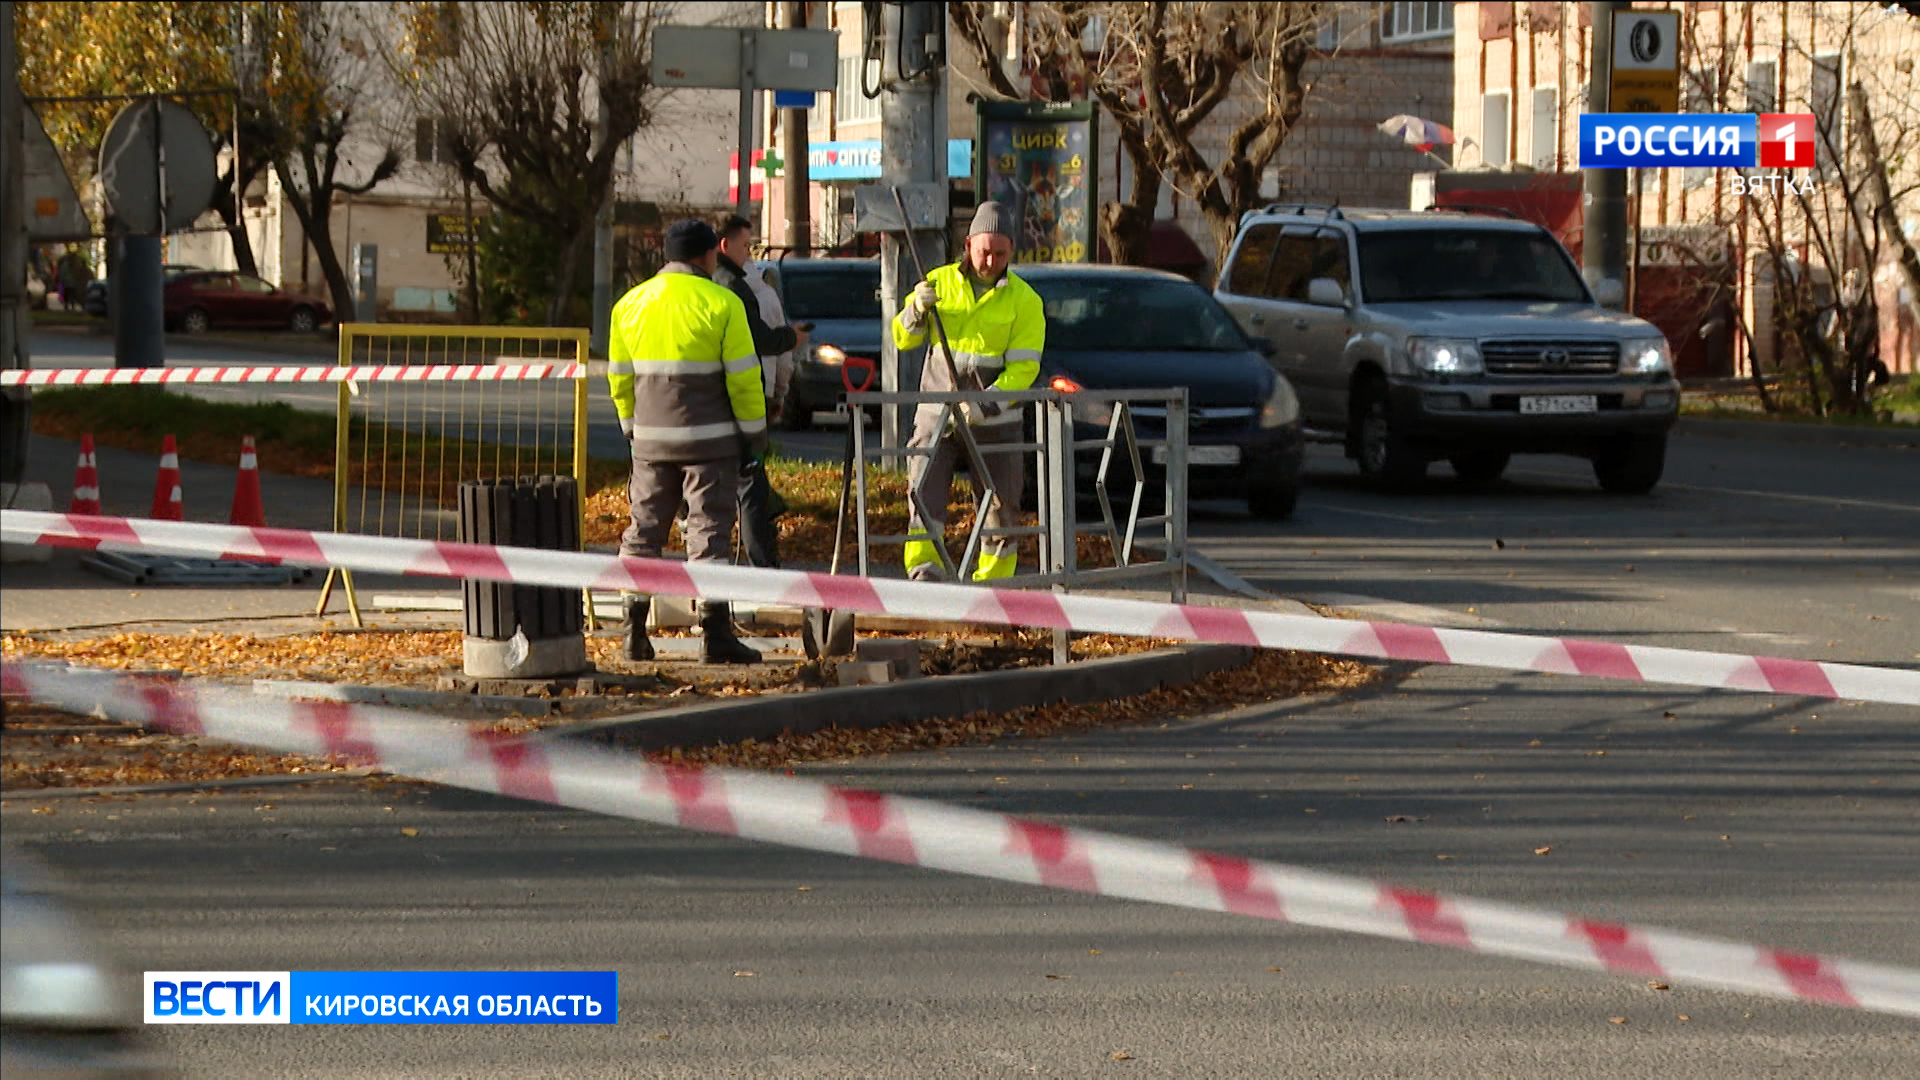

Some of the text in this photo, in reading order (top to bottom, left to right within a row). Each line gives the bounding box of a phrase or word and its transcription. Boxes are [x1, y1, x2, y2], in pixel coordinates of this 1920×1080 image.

[1012, 133, 1068, 150] ЦИРК
[808, 148, 882, 167] ити апте
[1001, 153, 1017, 169] 31
[1071, 153, 1082, 169] 6
[1009, 241, 1086, 264] ИРАФ
